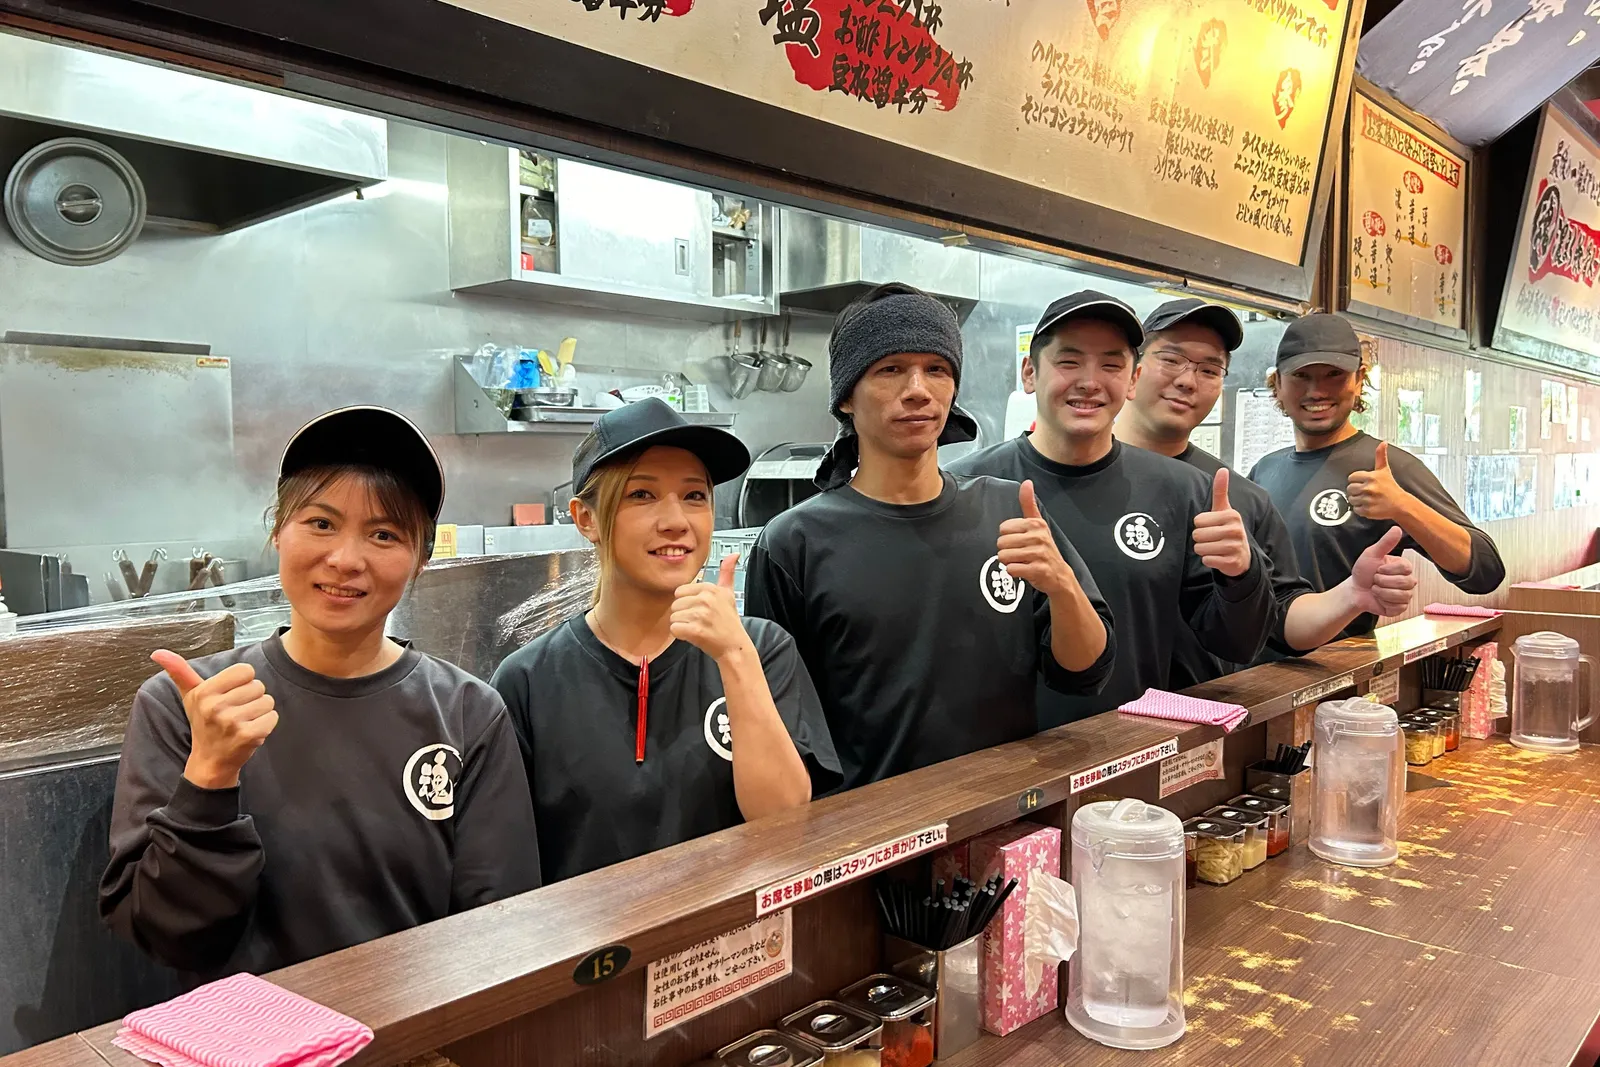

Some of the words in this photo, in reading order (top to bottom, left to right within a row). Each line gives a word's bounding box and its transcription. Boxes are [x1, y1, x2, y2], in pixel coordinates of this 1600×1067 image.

[1026, 792, 1038, 809] 14
[760, 830, 945, 909] お席を移動の際はスタッフにお声かけ下さい。
[592, 952, 615, 979] 15
